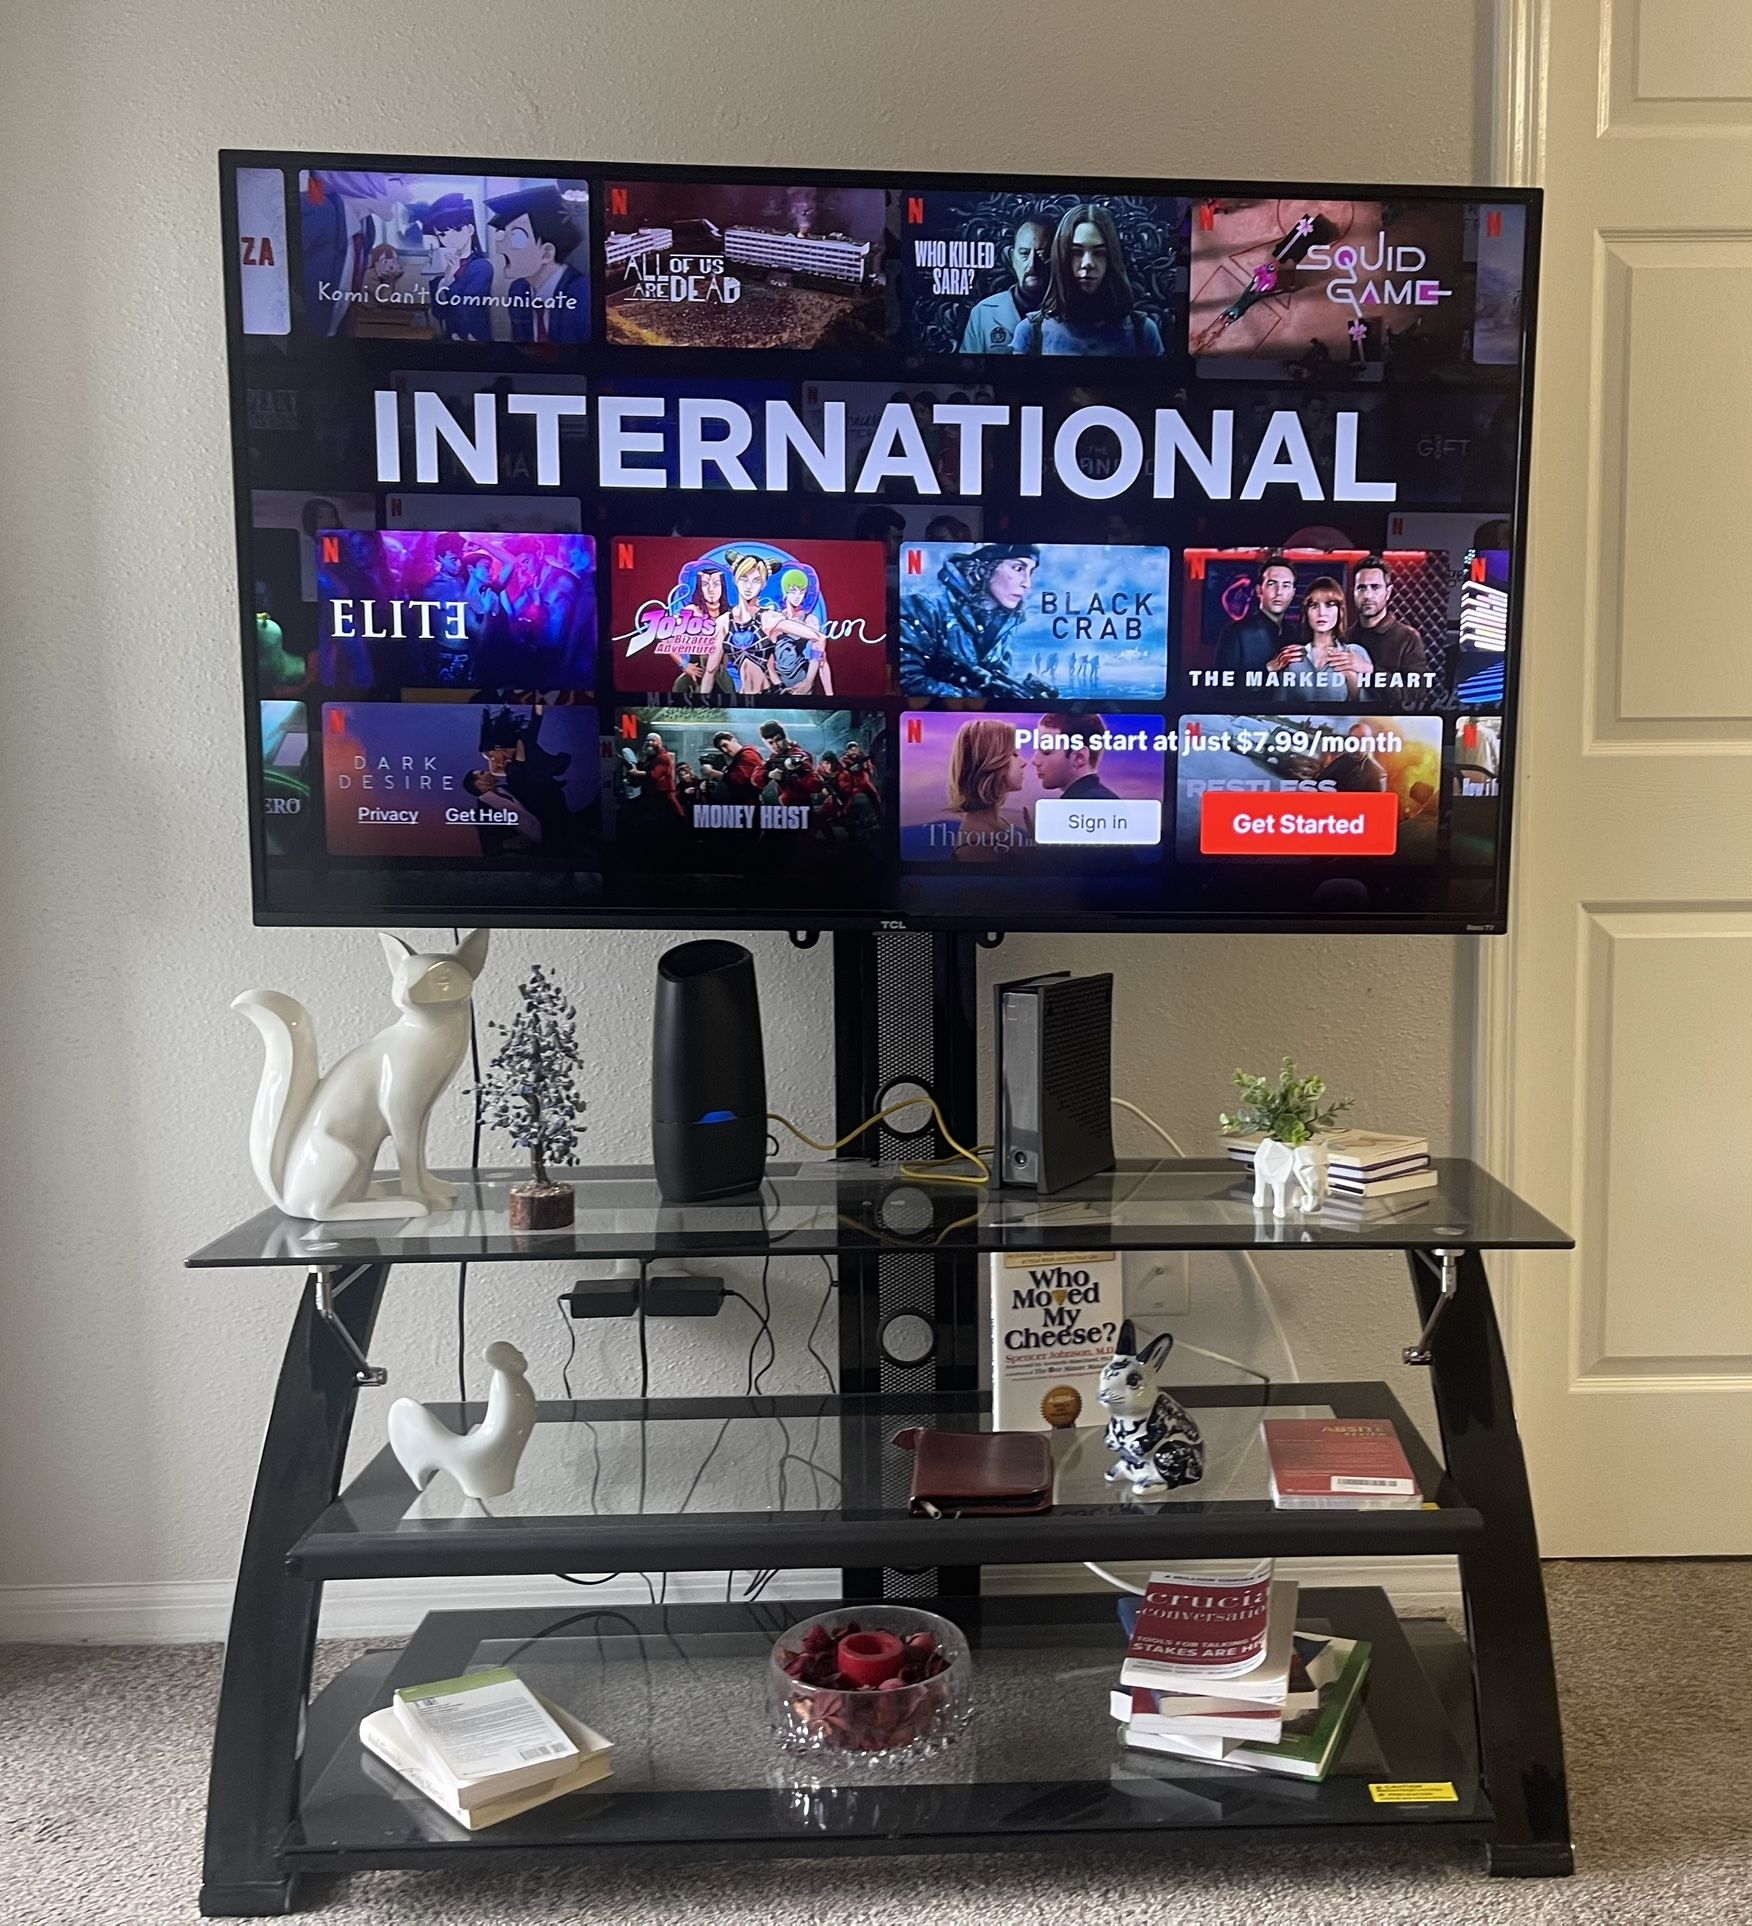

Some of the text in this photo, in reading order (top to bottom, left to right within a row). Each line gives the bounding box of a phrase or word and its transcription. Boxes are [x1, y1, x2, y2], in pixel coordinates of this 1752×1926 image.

[240, 237, 275, 266] ZA
[915, 240, 995, 269] WHO KILLED
[1296, 231, 1426, 277] SQUID
[624, 253, 724, 281] ALL OF US
[632, 275, 741, 303] ARE DEAD
[932, 268, 975, 295] SARA?
[318, 281, 577, 310] Komi Can't Communicate
[1326, 278, 1452, 318] GAME
[374, 390, 1397, 501] INTERNATIONAL
[1041, 591, 1153, 616] BLACK
[672, 634, 716, 645] Bizarre
[1052, 616, 1142, 640] CRAB
[655, 643, 716, 654] Adventure
[1189, 670, 1437, 688] THE MARKED HEART
[1015, 729, 1402, 756] Plans start at just $7.99/month
[354, 756, 437, 771] DARK
[339, 775, 454, 790] DESIRE
[358, 808, 418, 824] Privacy
[445, 809, 519, 824] Get Help
[693, 805, 810, 829] MONEY HEIST
[1068, 814, 1128, 833] Sign in
[1233, 814, 1365, 835] Get Started
[924, 823, 1023, 852] Through
[880, 921, 906, 929] TCL
[1029, 1267, 1090, 1289] Who
[1042, 1307, 1081, 1330] My
[1005, 1322, 1116, 1350] Cheese?
[1146, 1590, 1264, 1609] crucia
[1142, 1605, 1265, 1622] conversatio
[1132, 1642, 1198, 1657] STAKES
[1201, 1648, 1237, 1657] ARE
[1137, 1636, 1173, 1646] TOOLS
[1176, 1640, 1198, 1648] FOR
